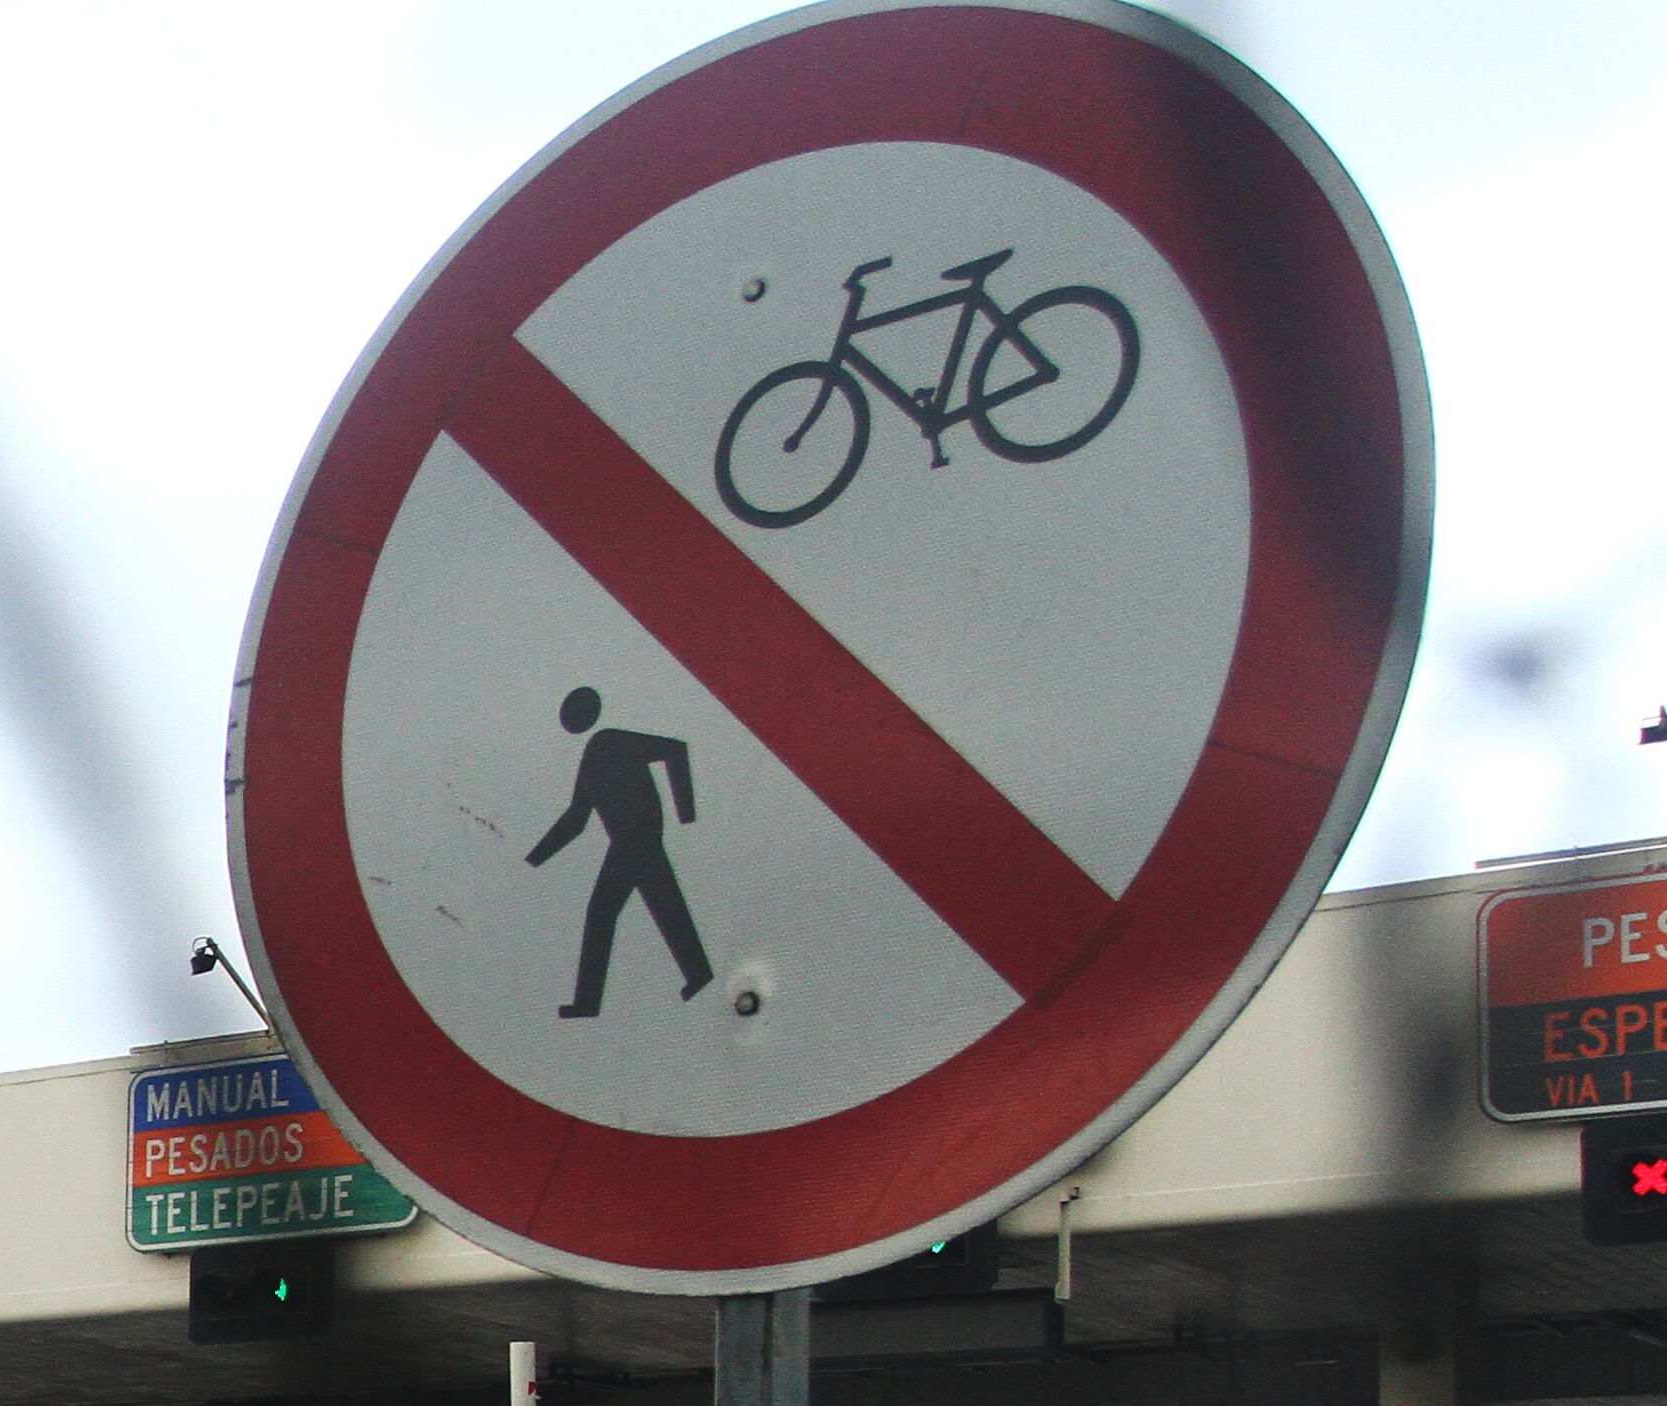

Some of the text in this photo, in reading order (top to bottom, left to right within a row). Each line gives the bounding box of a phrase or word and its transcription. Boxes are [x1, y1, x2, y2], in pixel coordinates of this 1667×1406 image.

[147, 1069, 289, 1122] MANUAL
[1546, 1070, 1633, 1106] VIA 1
[145, 1122, 304, 1178] PESADOS
[145, 1174, 354, 1235] TELEPEAJE
